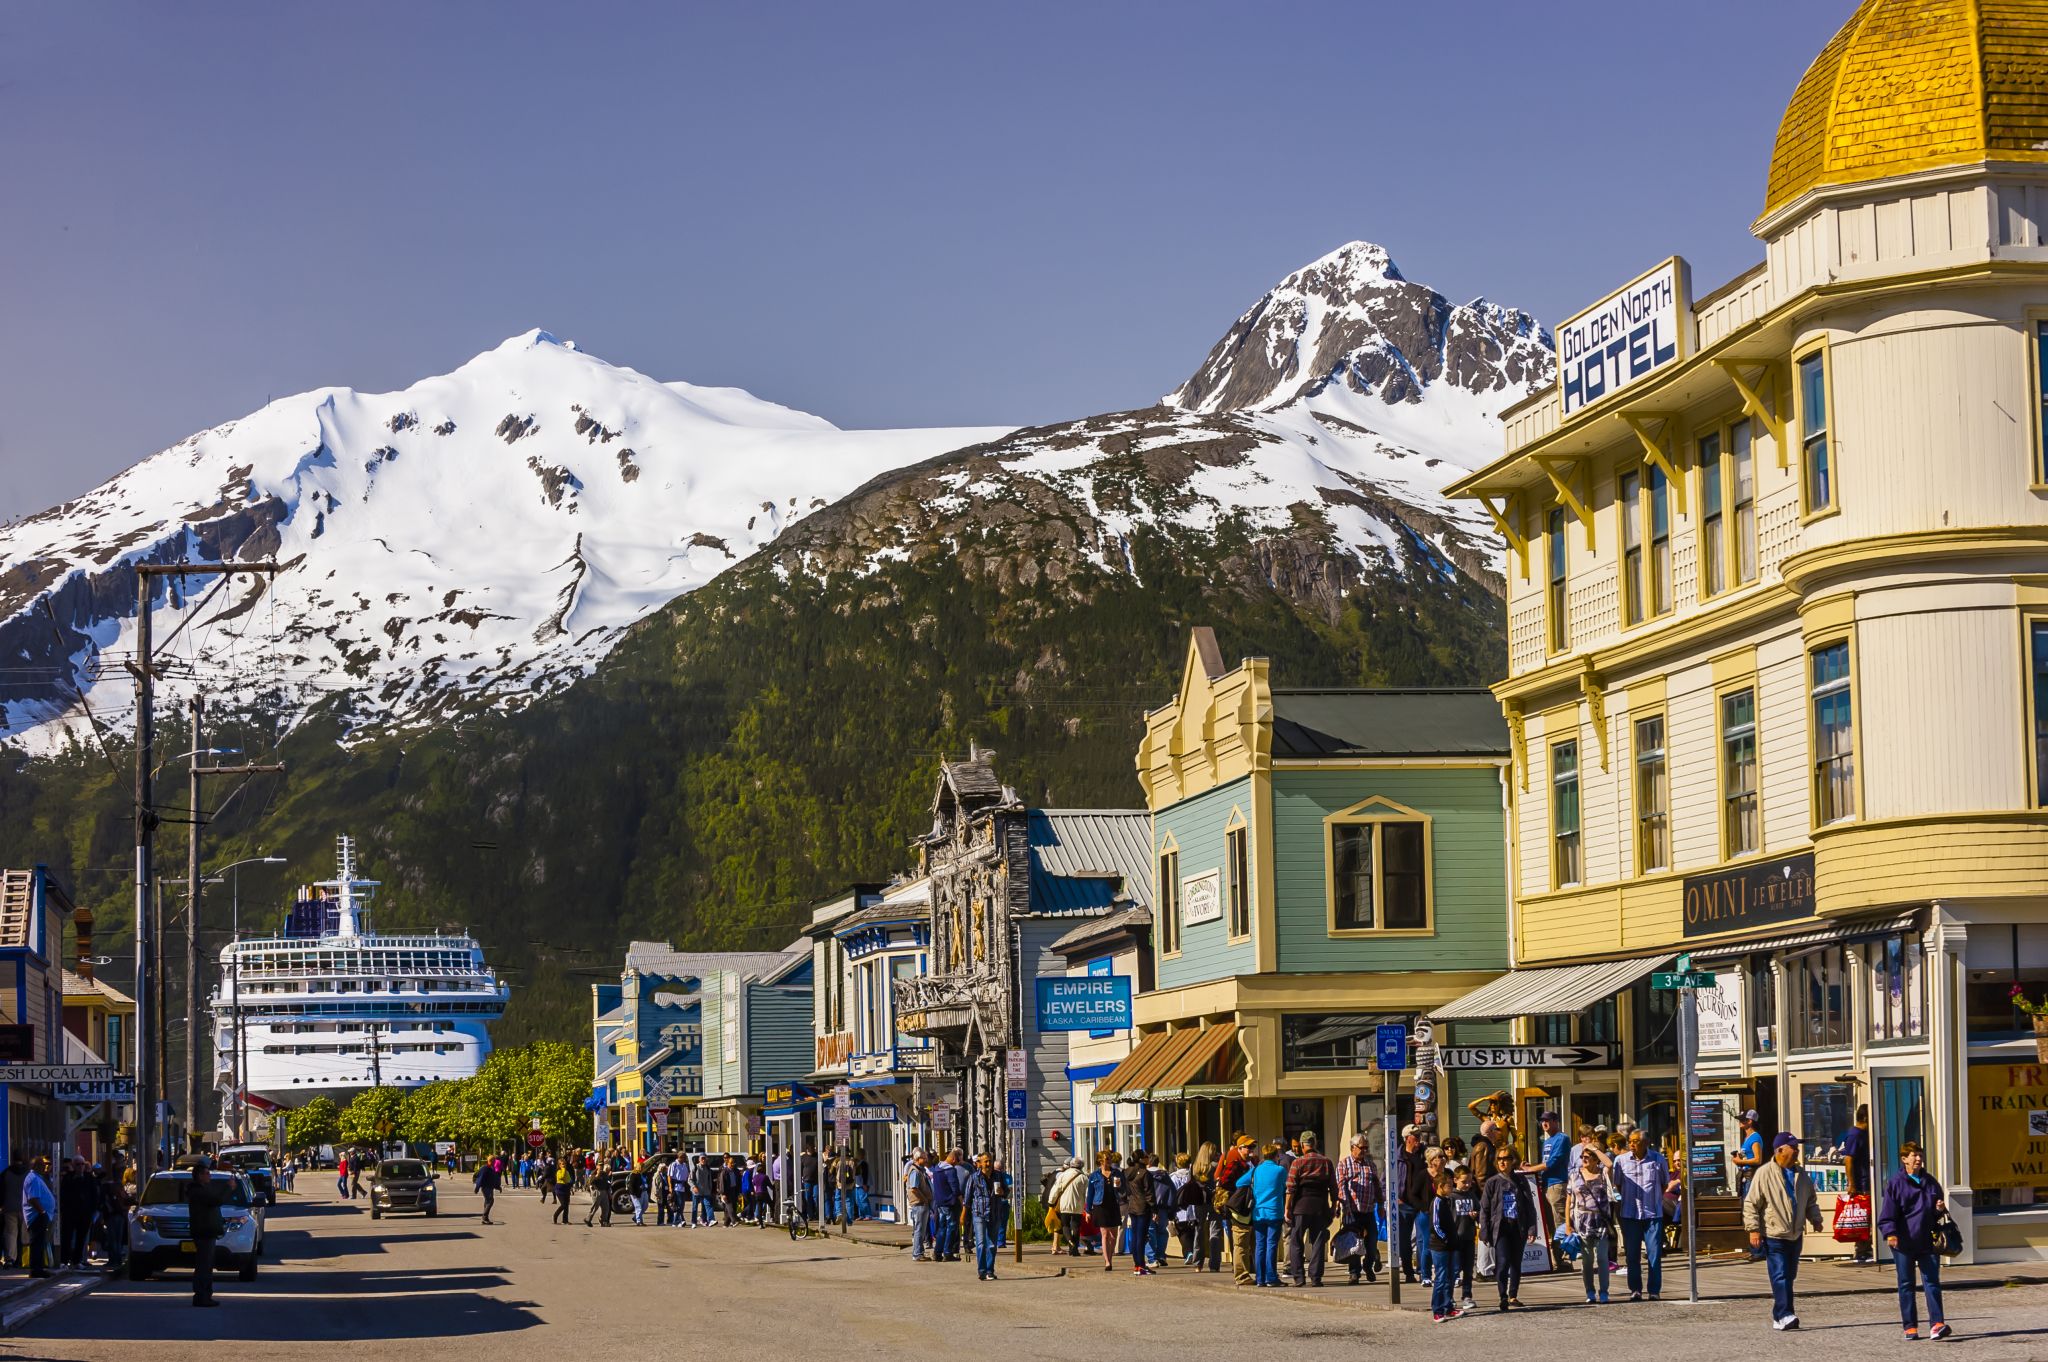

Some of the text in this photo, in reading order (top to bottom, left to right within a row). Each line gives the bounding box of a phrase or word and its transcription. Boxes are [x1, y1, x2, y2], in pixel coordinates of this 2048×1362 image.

[1563, 276, 1672, 364] GOLDEN NORTH
[1563, 318, 1676, 414] HOTEL
[1687, 877, 1812, 924] OMNI JEWELER
[1684, 975, 1703, 986] AVE
[1053, 982, 1113, 996] EMPIRE
[1042, 1000, 1126, 1014] JEWELERS
[1043, 1016, 1126, 1025] ALASKA CARIBBEAN
[1439, 1049, 1547, 1067] MUSEUM
[31, 1068, 79, 1080] LOCAL
[83, 1067, 112, 1079] ART
[2008, 1065, 2048, 1088] FR
[1979, 1095, 2037, 1110] TRAIN
[694, 1108, 718, 1119] THE
[851, 1107, 892, 1119] GEM-HOUSE
[689, 1121, 723, 1132] LOOM
